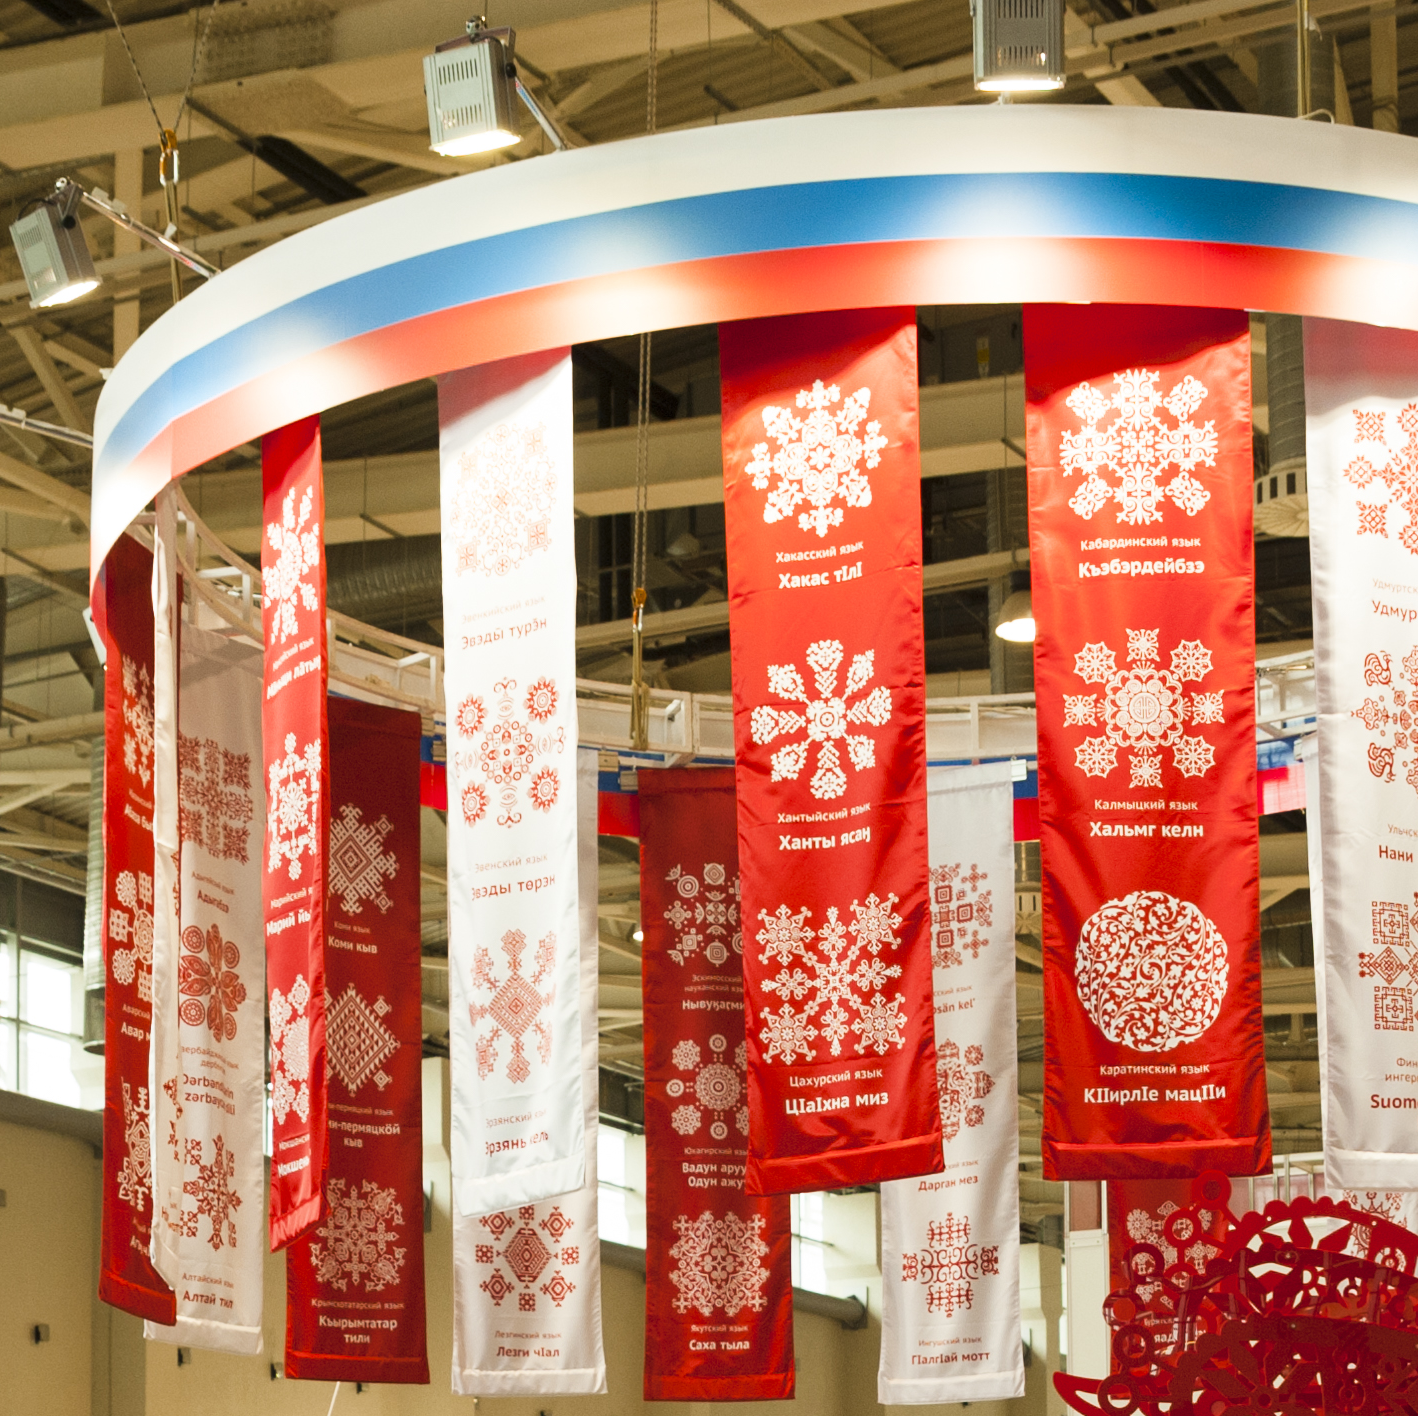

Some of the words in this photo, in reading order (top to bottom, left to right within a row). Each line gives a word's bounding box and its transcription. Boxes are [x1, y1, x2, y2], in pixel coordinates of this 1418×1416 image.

[1081, 536, 1168, 551] Кабардинский
[1172, 537, 1201, 548] язык
[776, 546, 836, 563] Хакасский
[840, 541, 864, 556] язык
[1079, 558, 1205, 579] Къэбэрдейбзэ
[779, 571, 830, 589] Хакас
[777, 808, 848, 824] Хантыйский
[850, 802, 871, 816] язык
[1094, 799, 1166, 812] Калмыцкий
[1169, 801, 1198, 811] язык
[1090, 821, 1156, 838] Хальмг
[1161, 823, 1204, 838] келн
[779, 834, 836, 851] Ханты
[525, 853, 549, 866] язык
[1379, 845, 1414, 863] Нани
[328, 935, 354, 951] Коми
[356, 943, 379, 954] кыв
[121, 1021, 144, 1041] Авар
[789, 1070, 851, 1088] Цахурский
[854, 1068, 883, 1080] язык
[1100, 1064, 1177, 1078] Каратинский
[1181, 1063, 1210, 1075] язык
[855, 1092, 889, 1107] миз
[344, 1137, 363, 1149] кыв
[682, 1162, 717, 1175] Вадун
[688, 1175, 717, 1189] Одун
[720, 1177, 746, 1190] ажу
[918, 1180, 957, 1192] Дарган
[959, 1175, 979, 1186] мез
[183, 1289, 216, 1307] Алтай
[319, 1314, 399, 1332] Къырымтатар
[691, 1324, 727, 1334] Якутский
[729, 1325, 749, 1334] язык
[343, 1333, 371, 1345] тили
[494, 1330, 541, 1340] Лезгинский
[542, 1331, 562, 1340] язык
[918, 1337, 961, 1348] Ингушский
[962, 1336, 982, 1345] язык
[496, 1346, 530, 1359] Лезги
[689, 1339, 716, 1351] Саха
[720, 1340, 750, 1351] тыла
[961, 1351, 991, 1363] мотт
